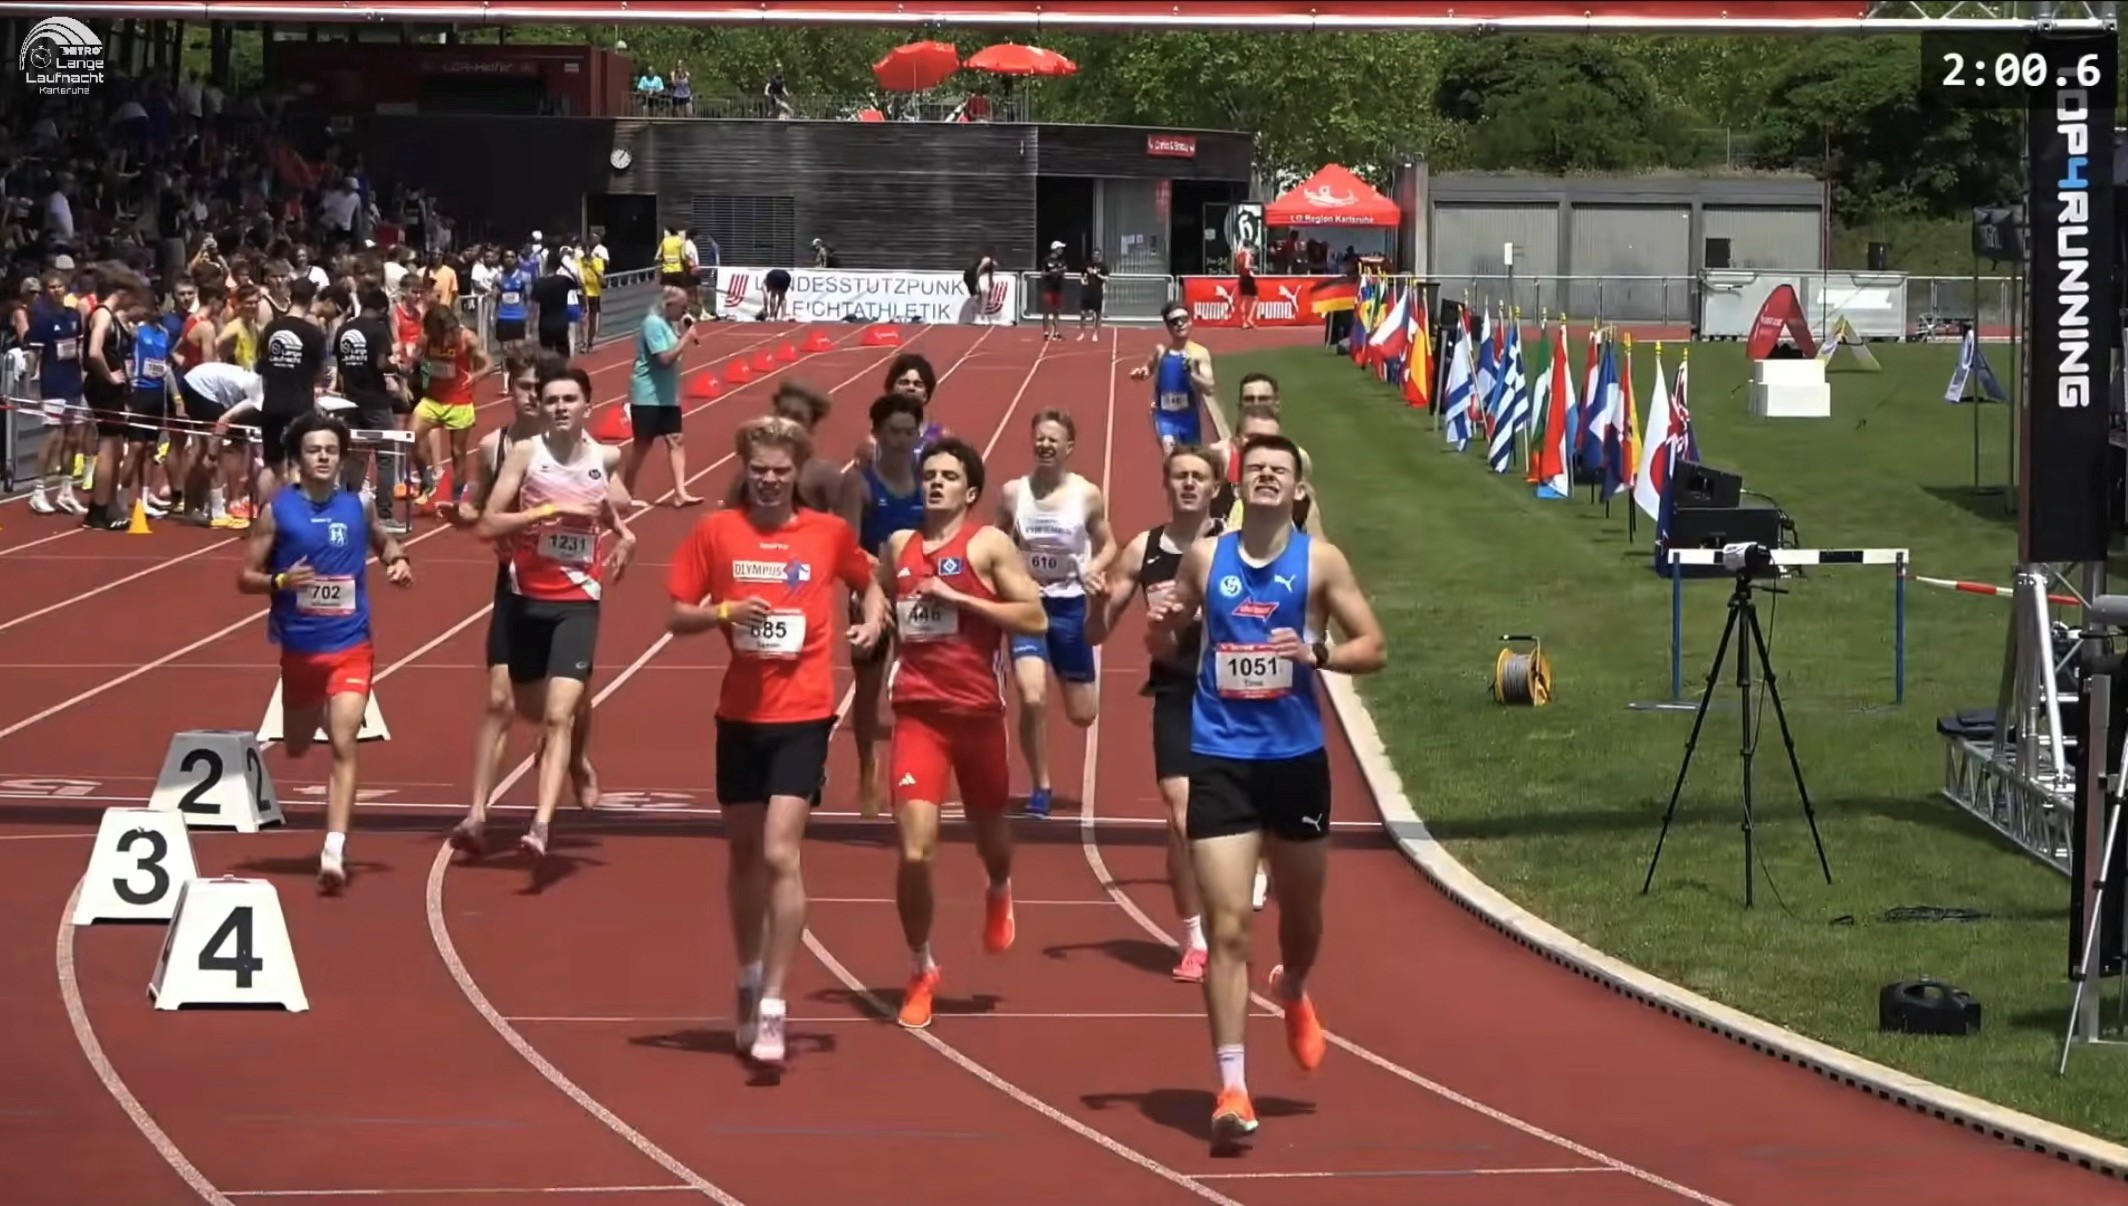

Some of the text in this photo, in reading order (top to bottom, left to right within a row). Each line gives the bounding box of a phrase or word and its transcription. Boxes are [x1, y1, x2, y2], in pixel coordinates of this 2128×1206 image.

[1305, 214, 1333, 223] Region
[1335, 214, 1375, 223] Karlsruhe
[782, 300, 951, 320] EICHTATHLETIK
[1193, 302, 1230, 320] PUMA
[1256, 302, 1293, 319] PUMA
[550, 535, 586, 551] 1231
[1032, 556, 1057, 569] 610
[312, 585, 341, 600] 702
[1228, 657, 1277, 676] 1051
[177, 748, 224, 815] 2
[246, 747, 272, 812] 2
[112, 828, 170, 906] 3
[198, 906, 263, 989] 4
